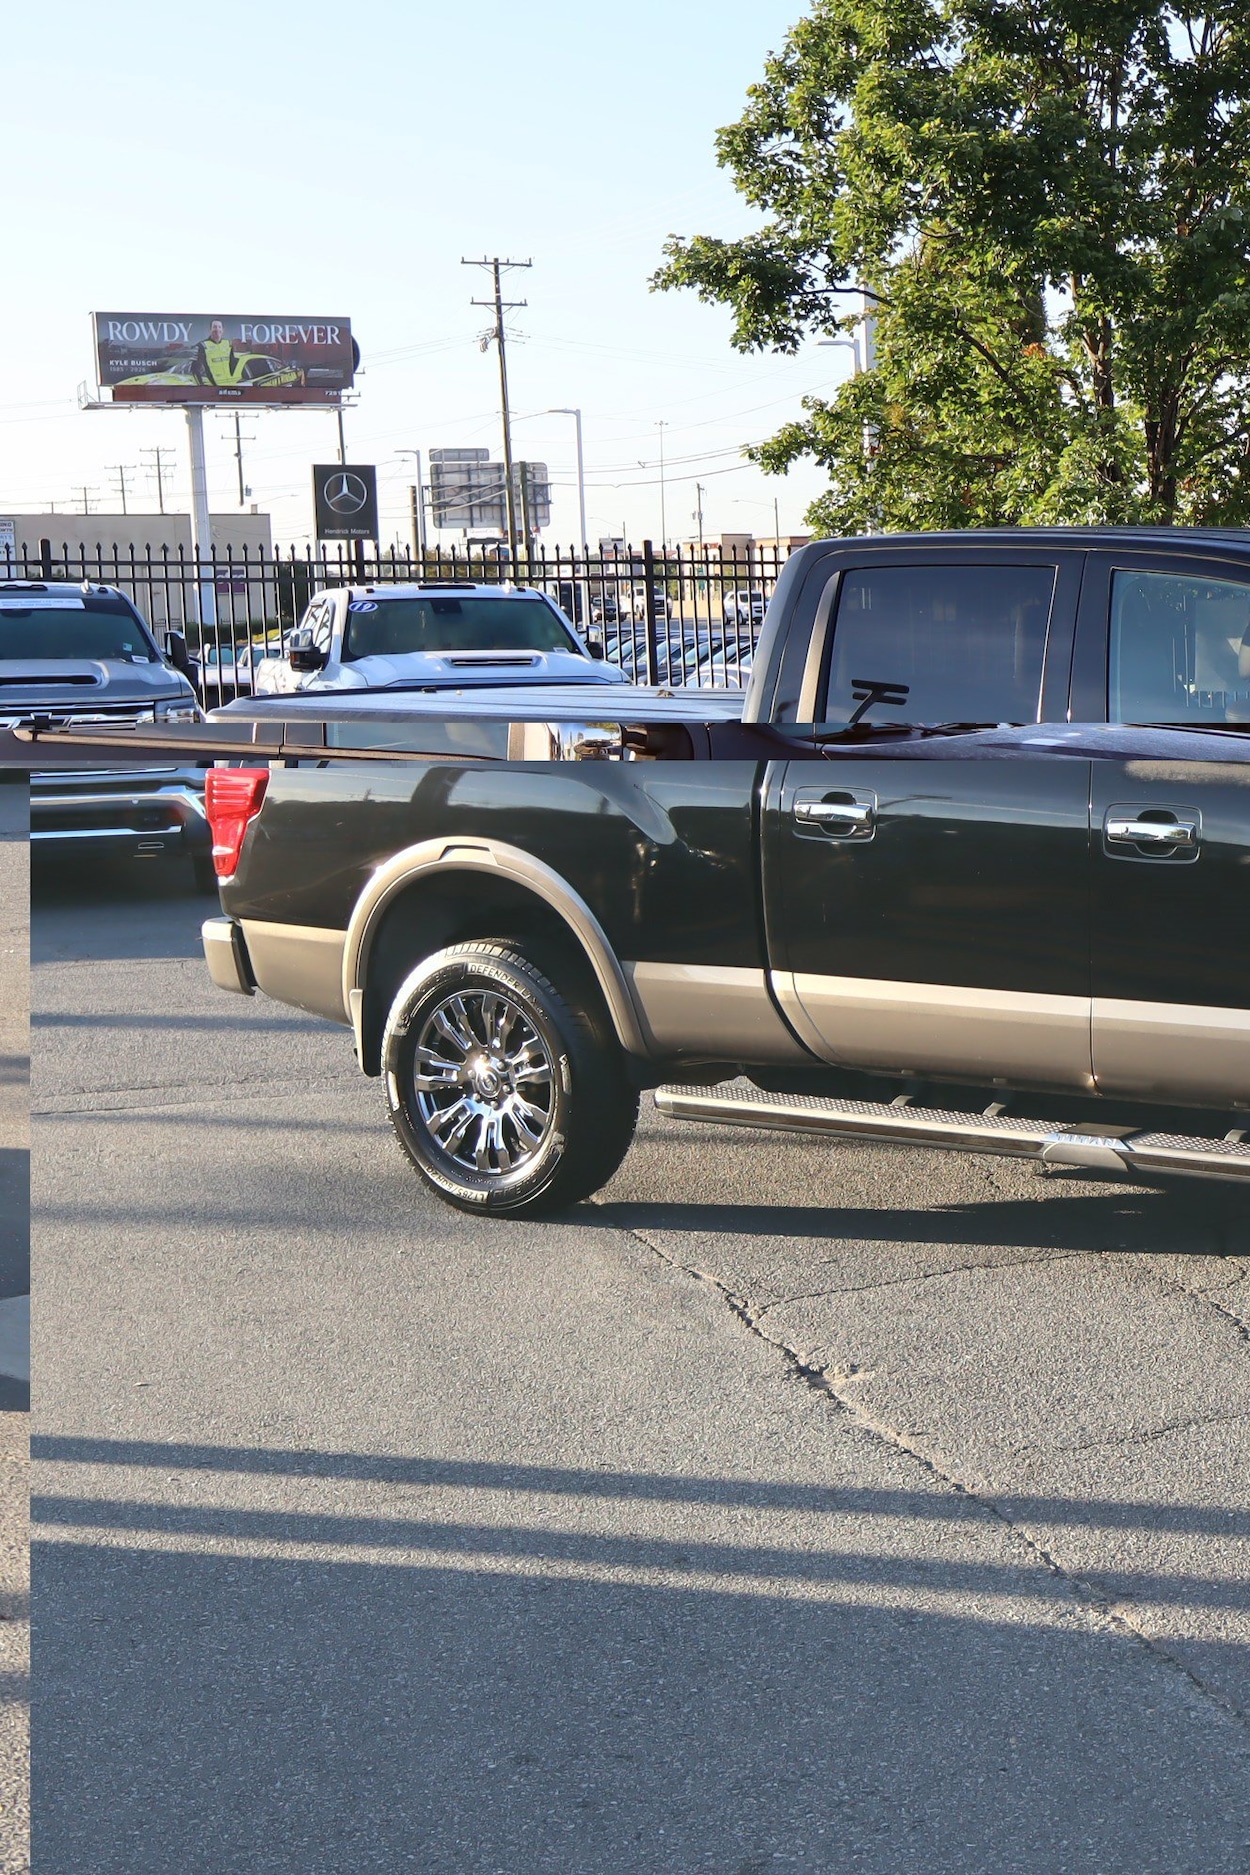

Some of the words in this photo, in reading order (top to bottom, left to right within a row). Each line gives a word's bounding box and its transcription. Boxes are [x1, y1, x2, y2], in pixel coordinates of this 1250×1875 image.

[107, 321, 192, 342] ROWDY
[240, 323, 341, 345] FOREVER
[470, 963, 521, 988] DEFENDER
